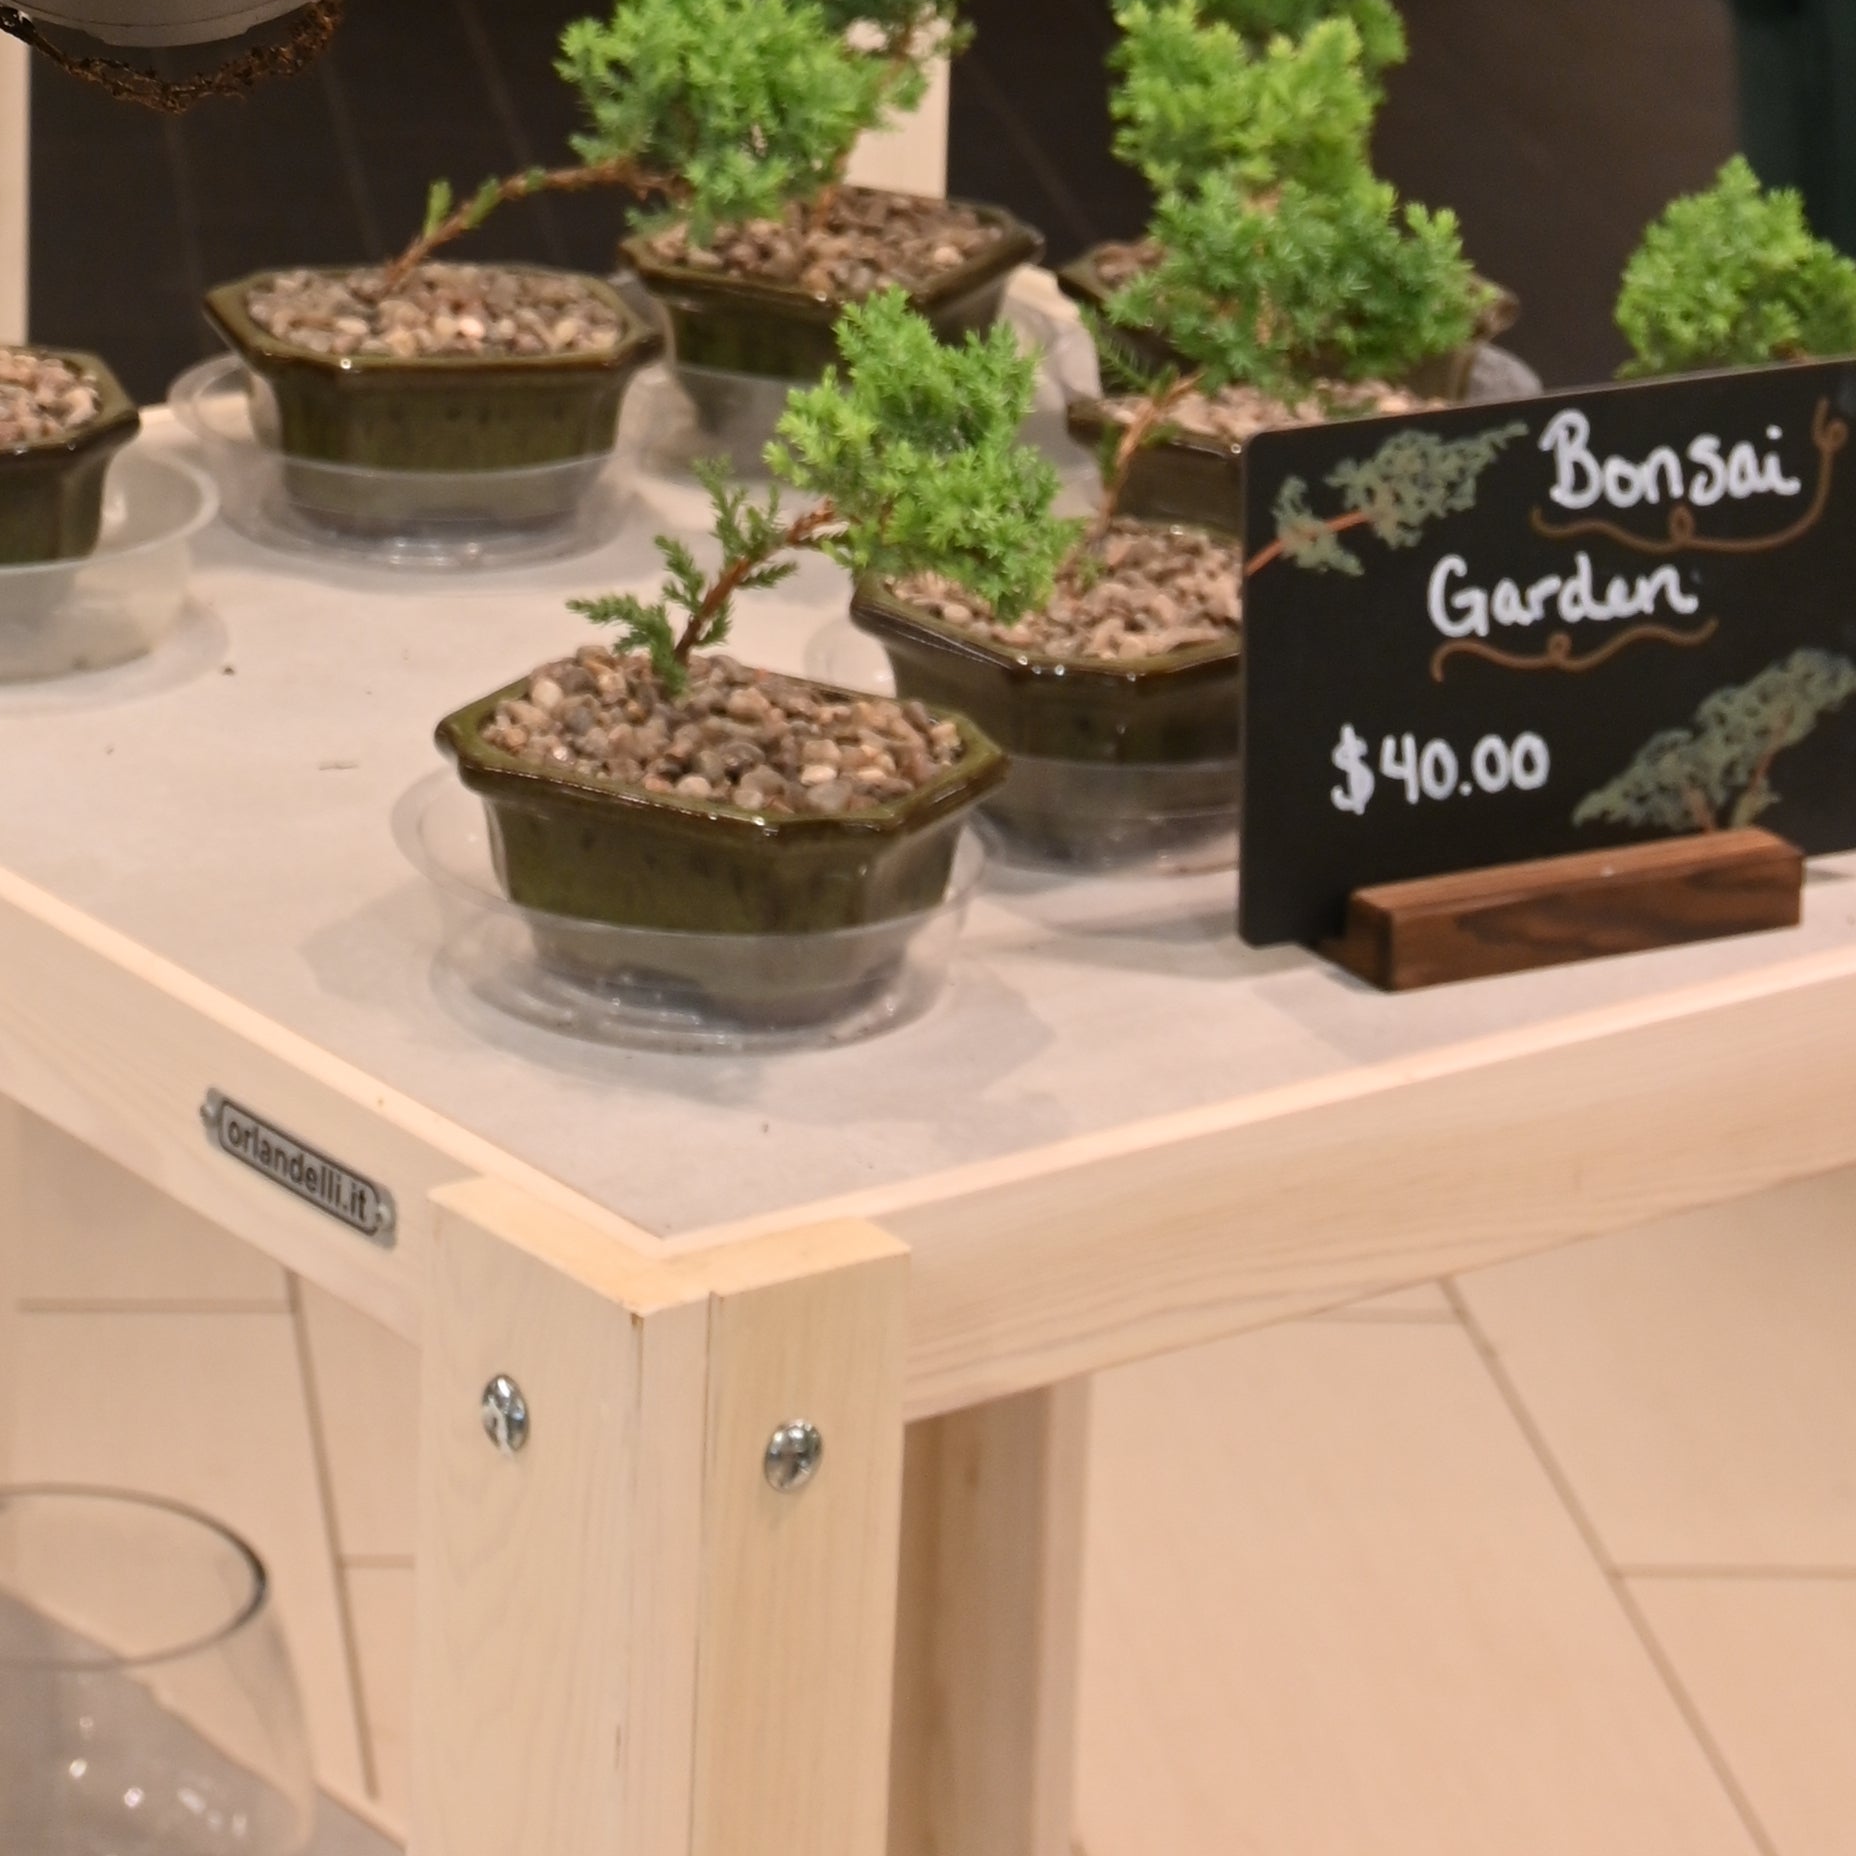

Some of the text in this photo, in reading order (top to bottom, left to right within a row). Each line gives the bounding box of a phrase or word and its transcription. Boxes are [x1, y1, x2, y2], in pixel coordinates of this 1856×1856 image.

[1539, 408, 1800, 508] Bonsai
[1428, 552, 1698, 636] Garden
[1330, 723, 1549, 814] $40.00
[228, 1121, 367, 1221] orlandelli.it
